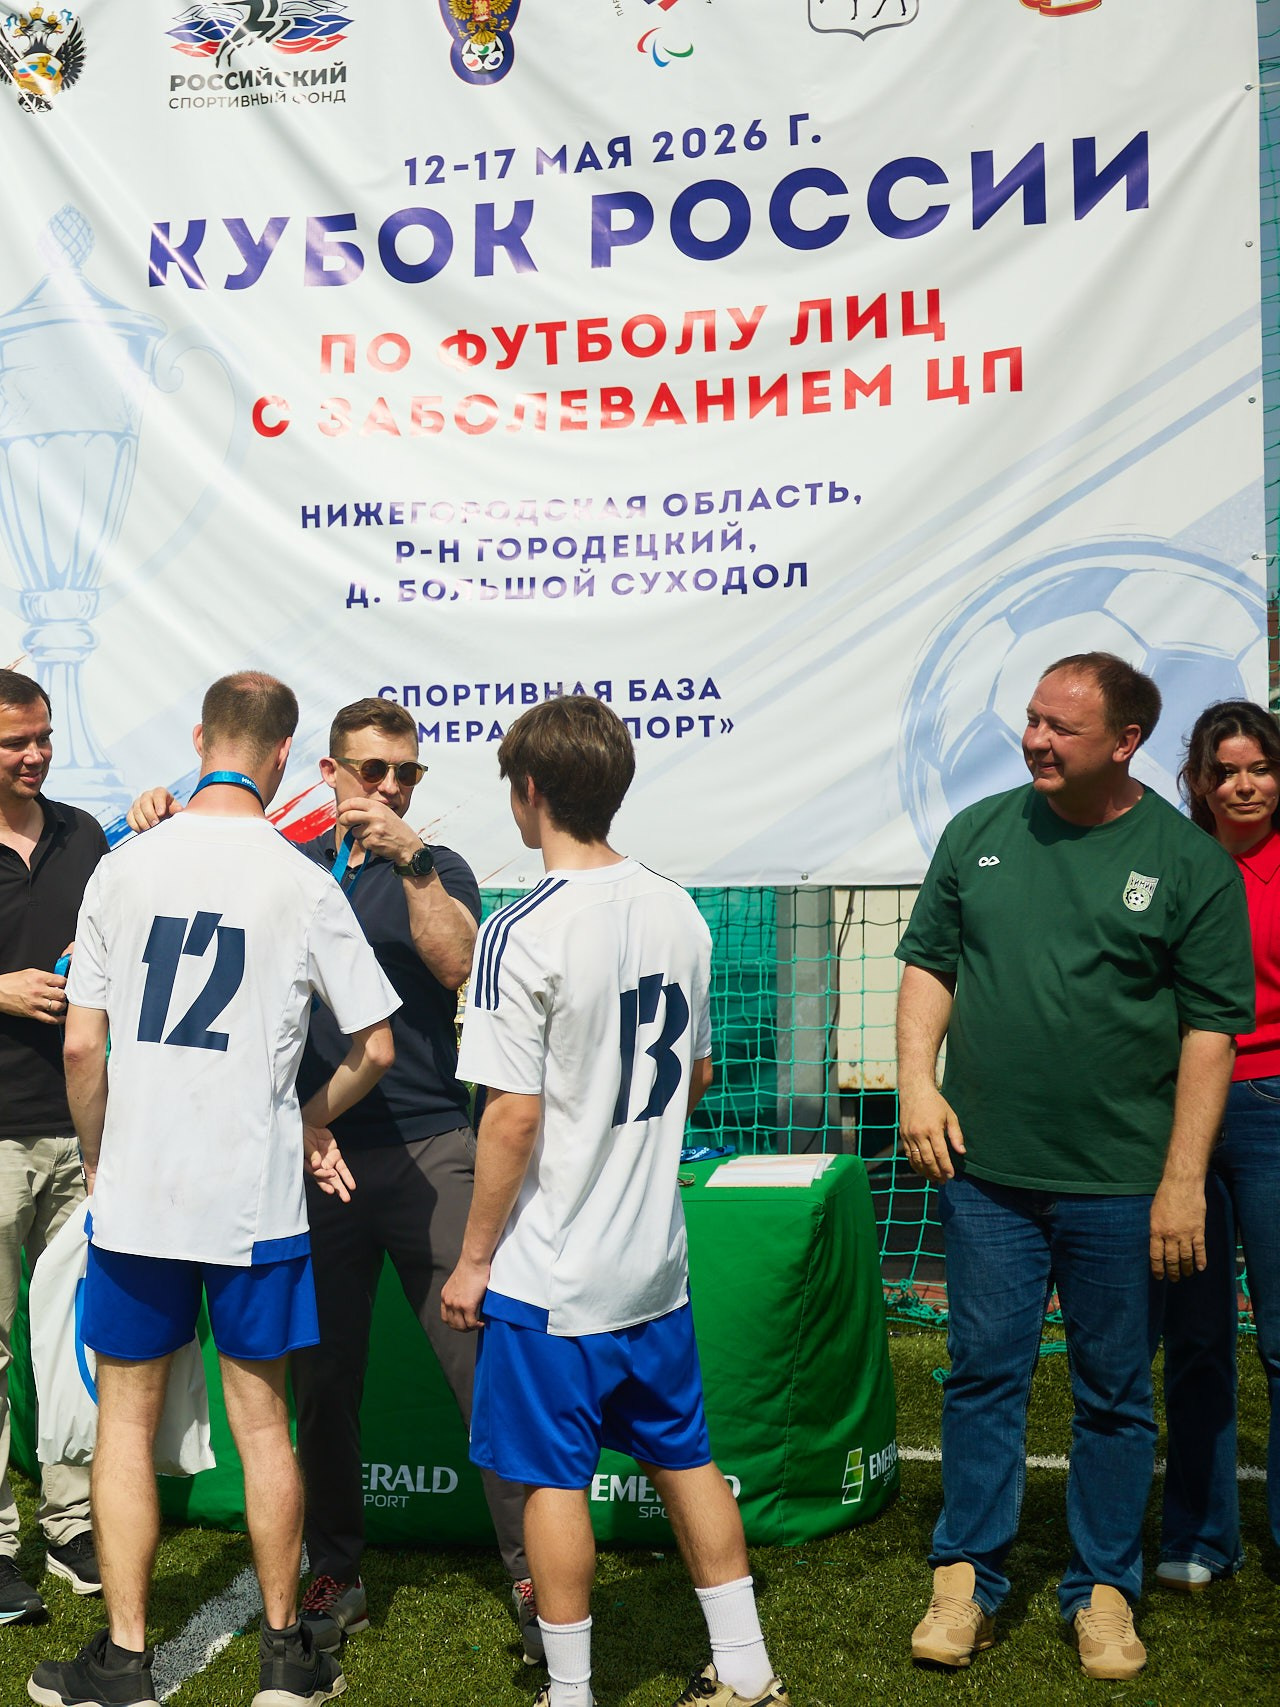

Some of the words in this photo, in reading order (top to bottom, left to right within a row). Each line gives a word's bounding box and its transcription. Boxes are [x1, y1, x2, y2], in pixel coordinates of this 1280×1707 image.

[170, 61, 347, 91] РОССИЙСКИЙ
[169, 91, 286, 109] СПОРТИВНЫЙ
[404, 148, 516, 187] 12-17
[535, 135, 632, 176] МАЯ
[652, 119, 768, 164] 2026
[789, 113, 823, 147] Г.
[148, 199, 539, 291] КУБОК
[590, 130, 1150, 269] РОССИИ
[321, 332, 411, 375] ПО
[438, 305, 768, 371] ФУТБОЛУ
[790, 288, 947, 346] ЛИЦ
[252, 394, 291, 438] С
[317, 363, 893, 438] ЗАБОЛЕВАНИЕМ
[927, 346, 1023, 406] ЦП
[301, 495, 647, 529] НИЖЕГОРОДСКАЯ
[663, 480, 862, 517] ОБЛАСТЬ,
[396, 538, 461, 564] Р-Н
[477, 521, 757, 562] ГОРОДЕЦКИЙ,
[346, 581, 381, 609] Д.
[399, 569, 595, 603] БОЛЬШОЙ
[611, 562, 808, 597] СУХОДОЛ
[378, 680, 612, 707] СПОРТИВНАЯ
[629, 677, 722, 702] БАЗА
[623, 715, 734, 740] ПОРТ»
[137, 911, 245, 1051] 12
[612, 973, 689, 1128] 13
[362, 1463, 458, 1494] RALD
[363, 1494, 410, 1508] PORT
[638, 1506, 670, 1519] SPO
